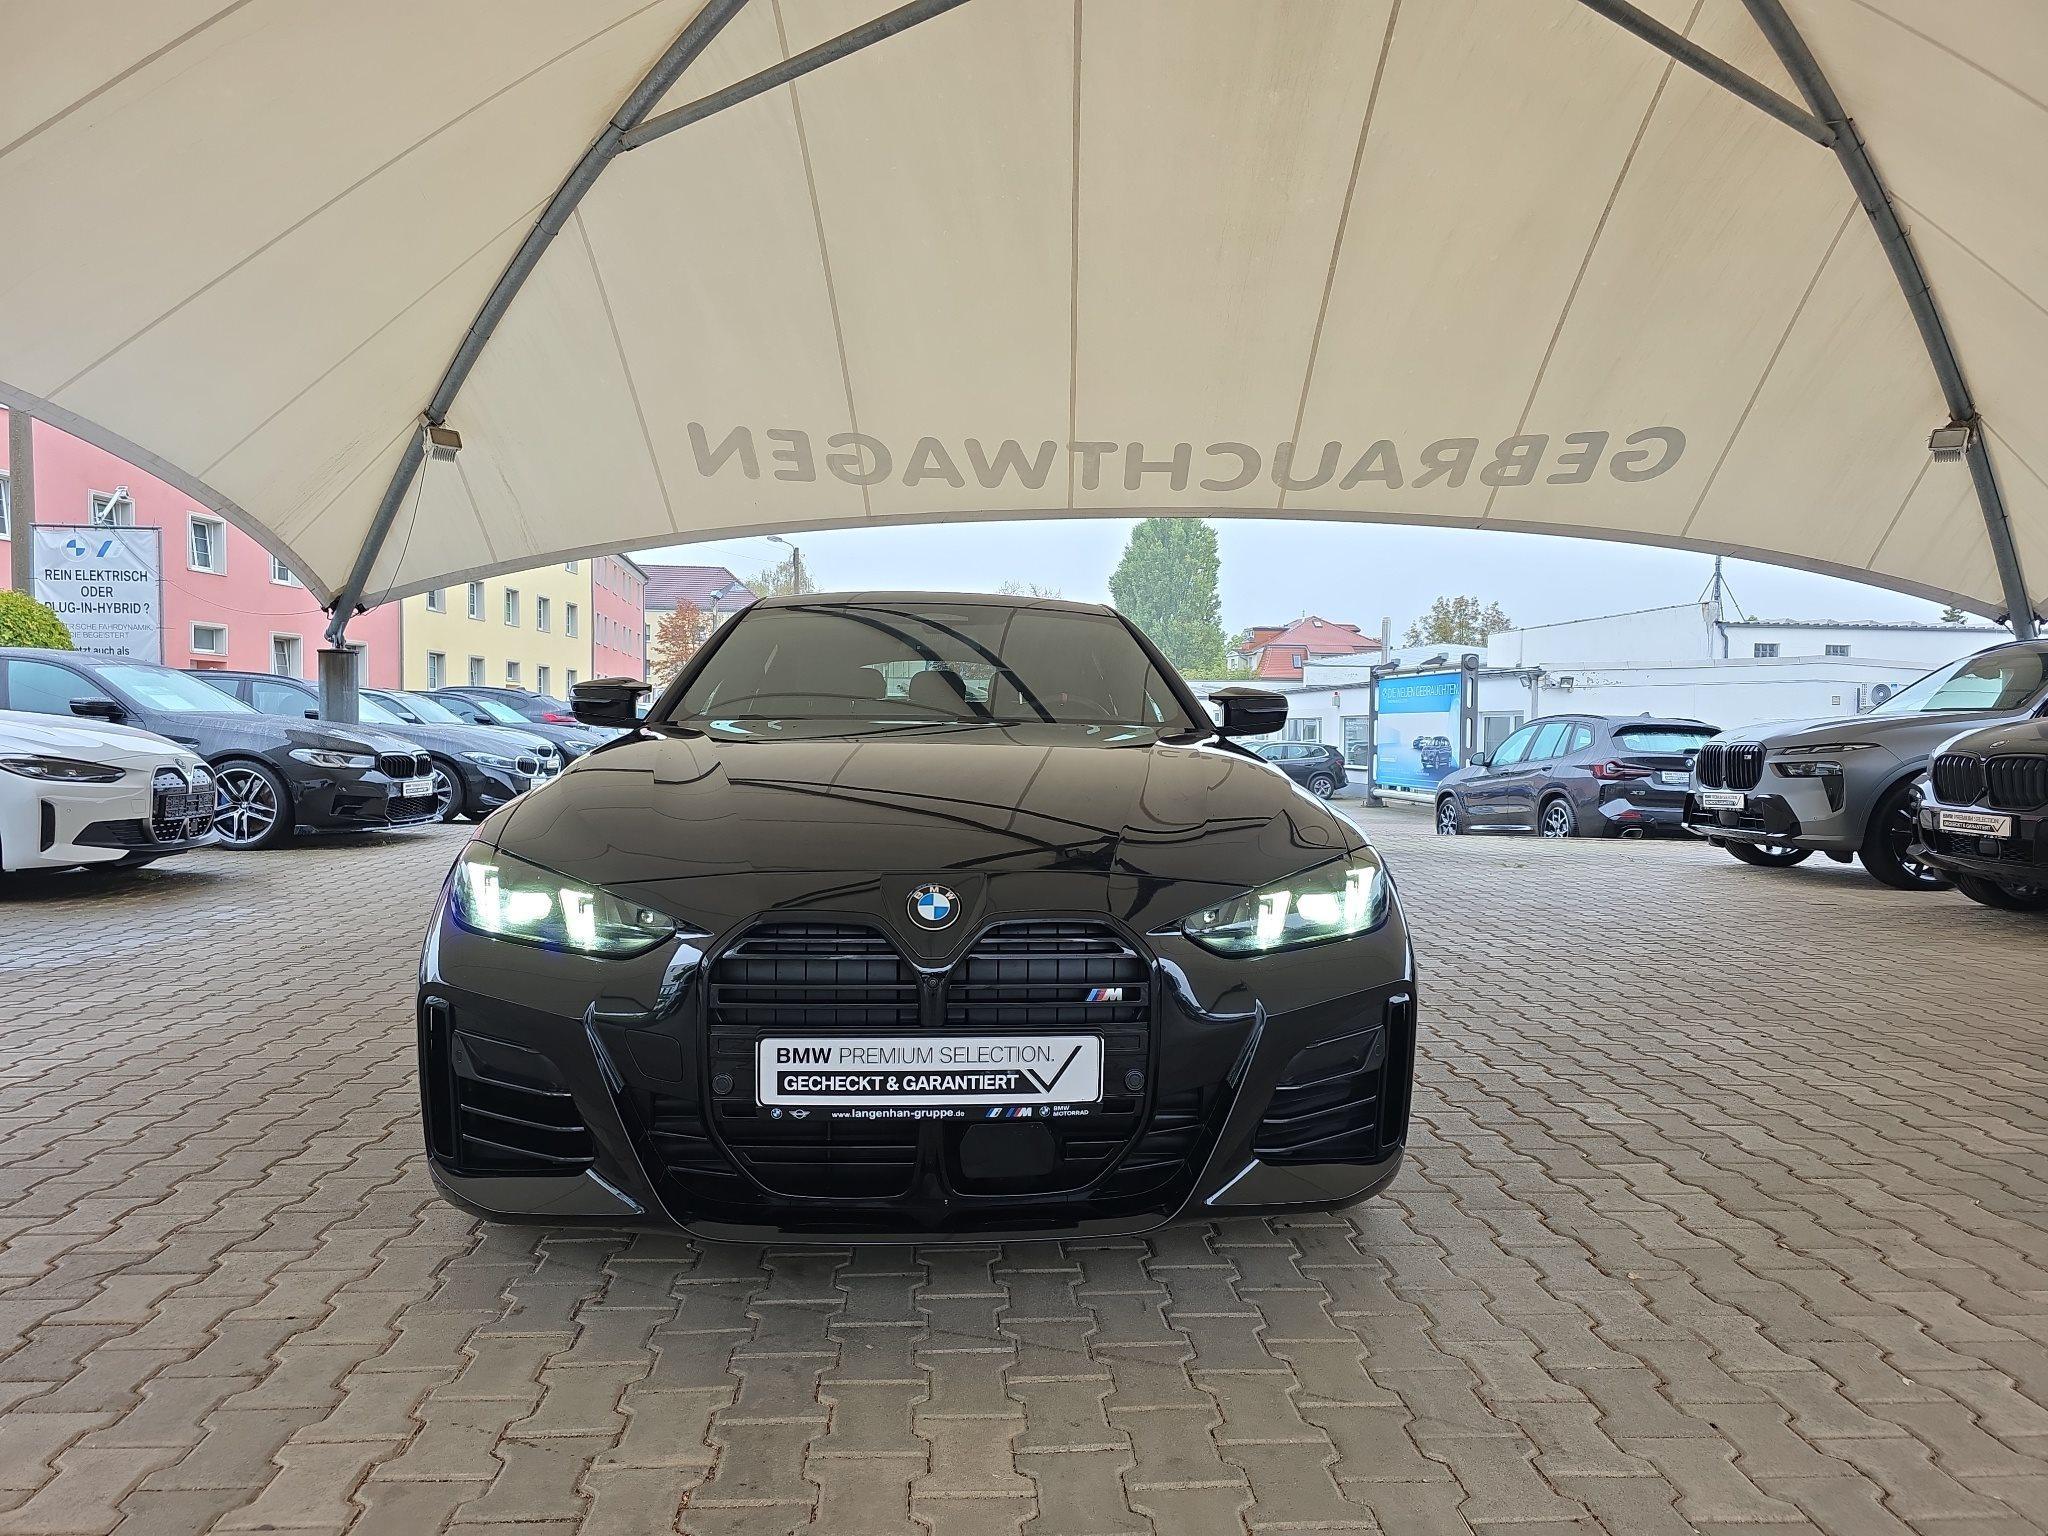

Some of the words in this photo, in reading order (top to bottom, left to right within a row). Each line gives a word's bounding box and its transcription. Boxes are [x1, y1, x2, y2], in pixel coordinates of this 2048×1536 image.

[45, 569, 72, 581] REIN
[75, 570, 148, 582] ELEKTRISCH
[80, 586, 113, 597] ODER
[117, 646, 129, 655] als
[914, 886, 956, 900] BMW
[776, 1048, 832, 1064] BMW
[839, 1047, 934, 1065] PREMIUM
[783, 1075, 885, 1091] GECHECKT
[887, 1076, 899, 1091] &
[903, 1074, 1020, 1091] GARANTIERT
[831, 1108, 965, 1120] www.langenhan-gruppe.de
